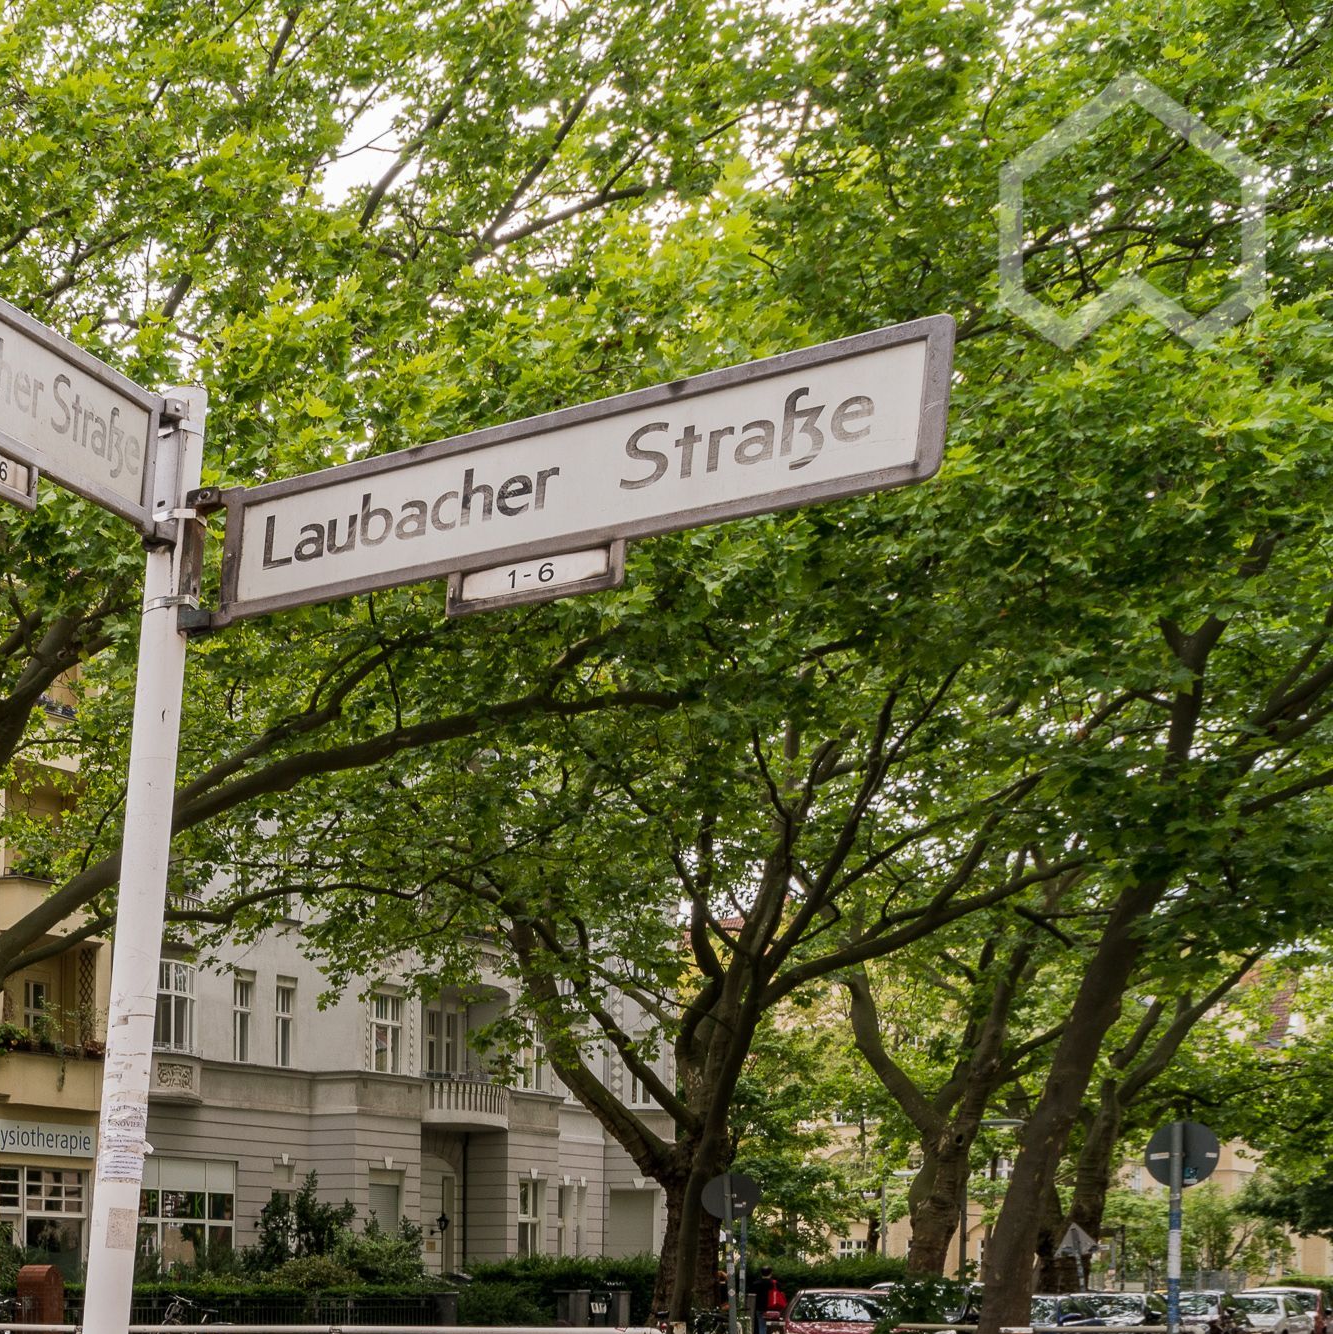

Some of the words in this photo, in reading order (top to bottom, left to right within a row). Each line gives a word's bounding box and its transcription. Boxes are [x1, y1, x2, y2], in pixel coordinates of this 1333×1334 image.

[50, 372, 140, 479] Straße
[262, 466, 560, 571] Laubacher
[619, 386, 875, 490] Straße
[506, 561, 555, 590] 1-6
